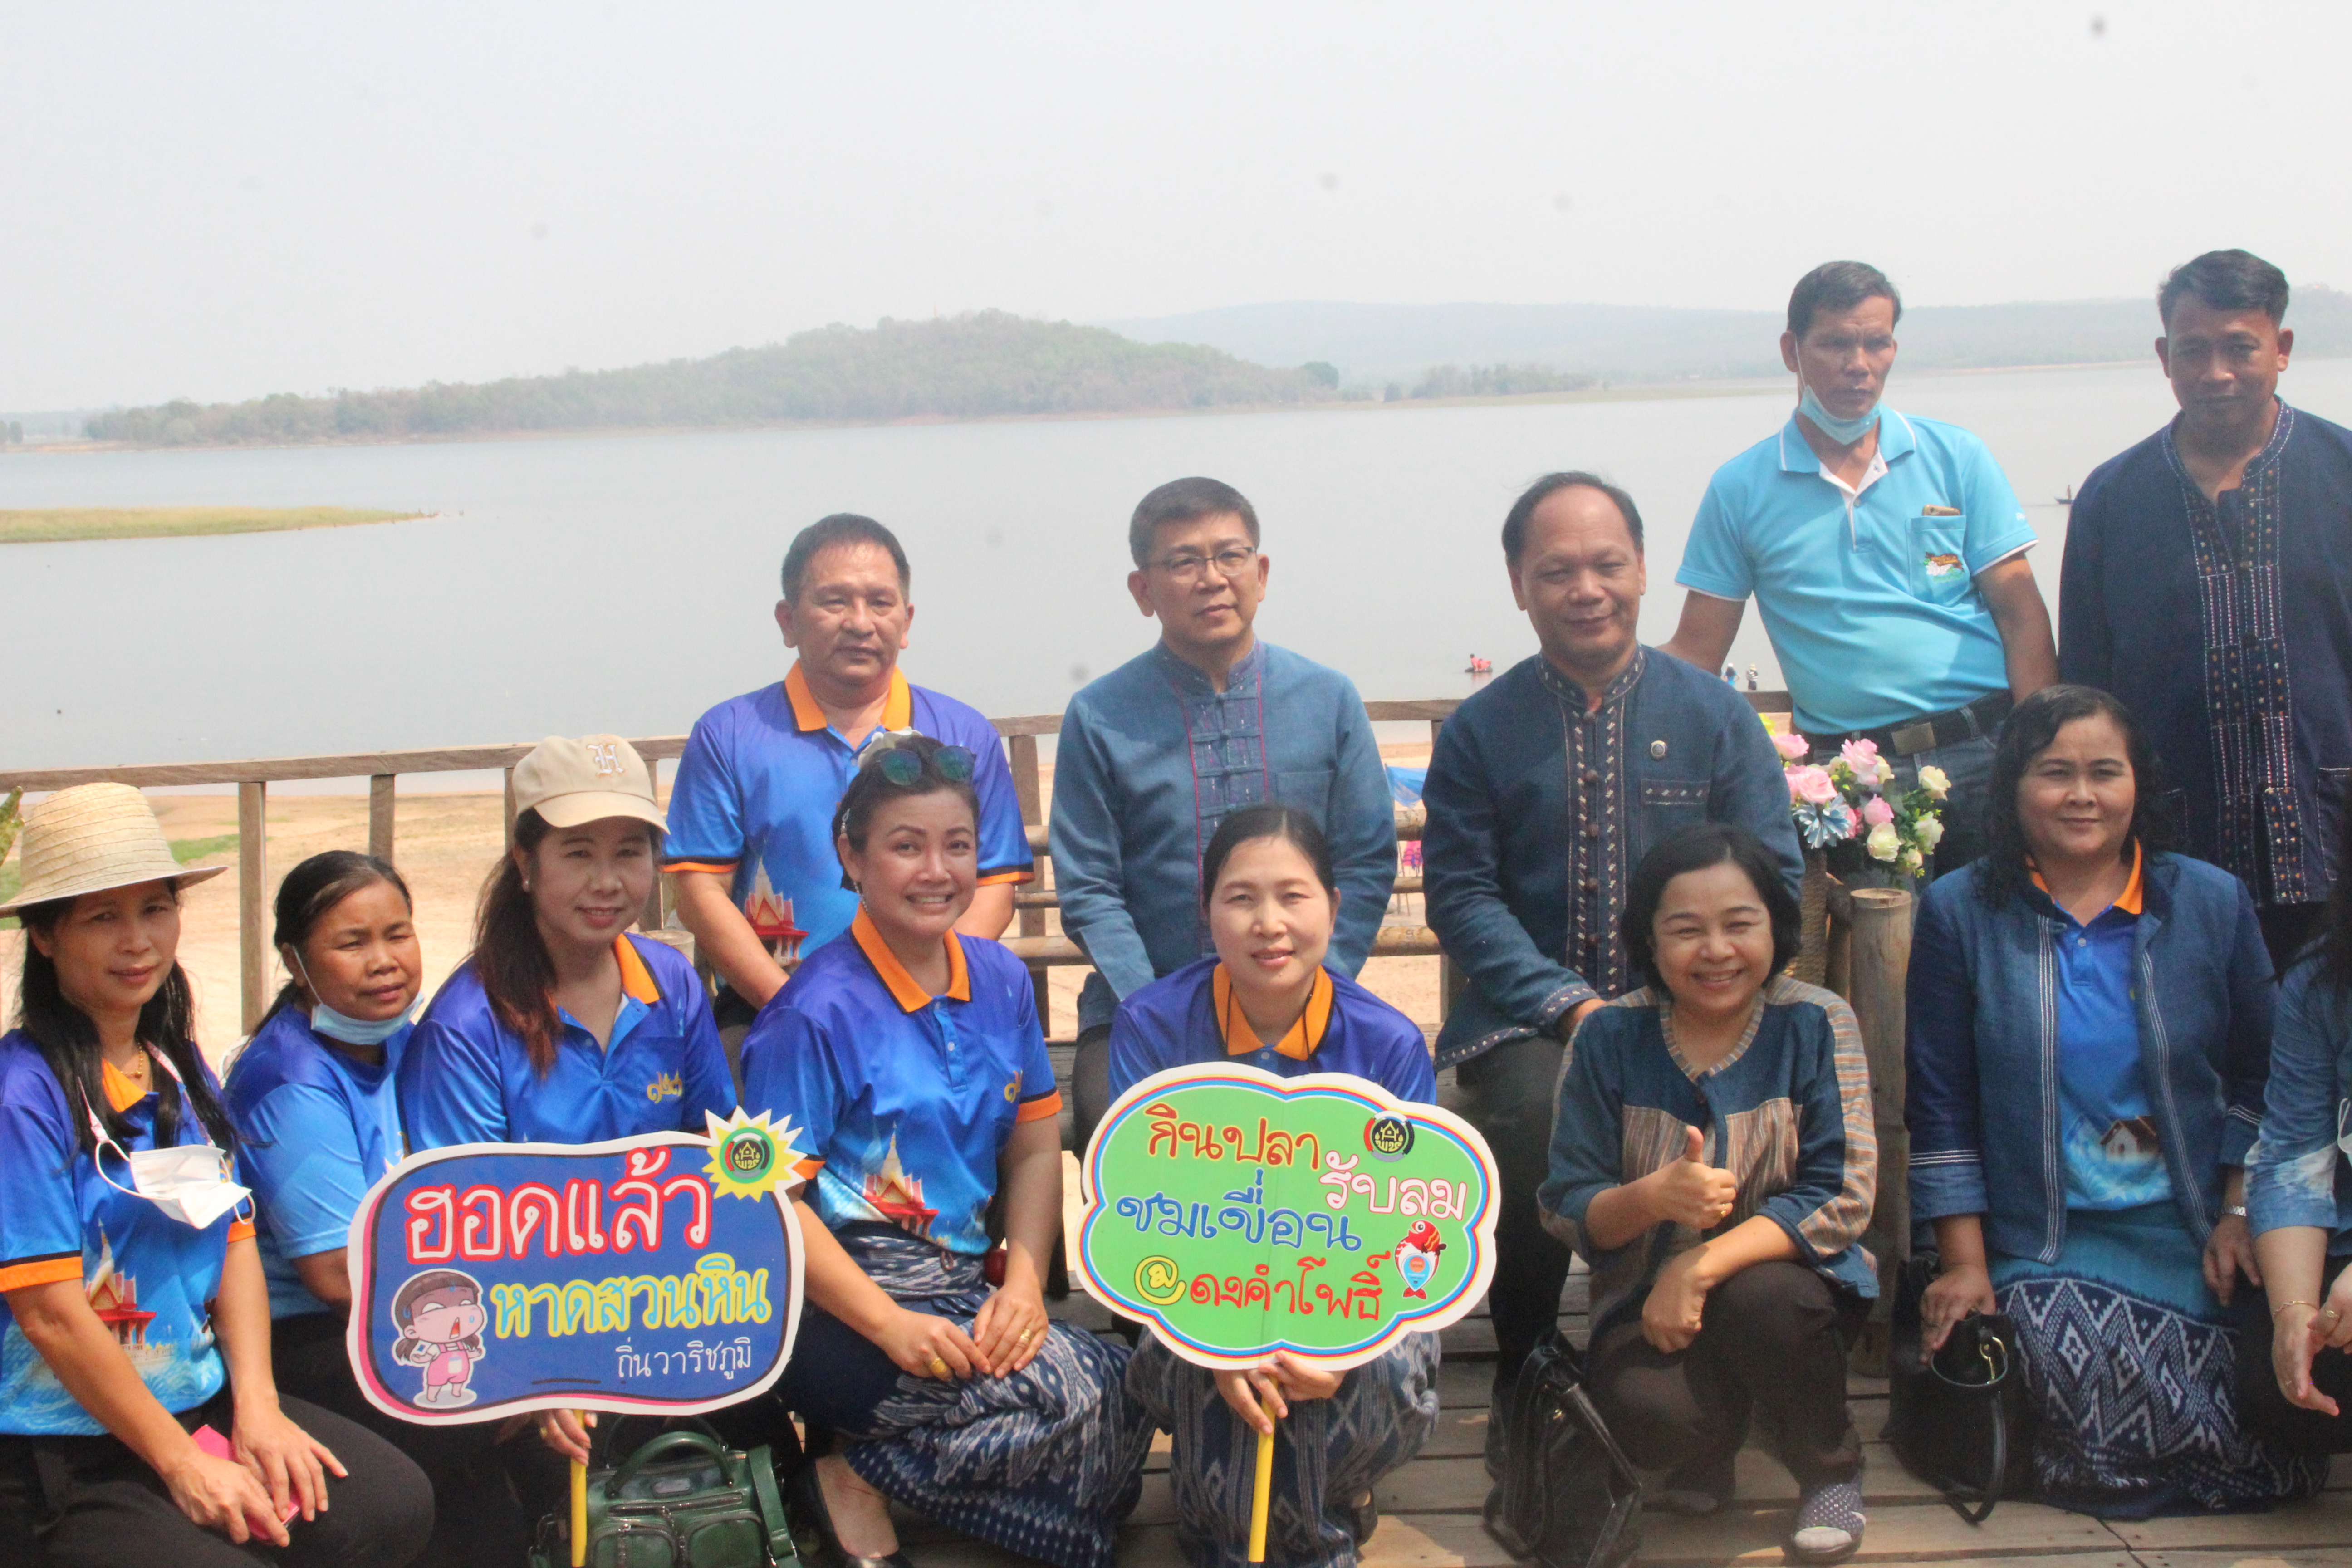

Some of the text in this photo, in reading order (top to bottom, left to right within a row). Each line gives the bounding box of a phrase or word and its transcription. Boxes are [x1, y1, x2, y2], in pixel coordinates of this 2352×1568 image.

[1145, 1102, 1319, 1171] กินปลา
[404, 1146, 712, 1264] ฮอดแล้ว
[1116, 1168, 1362, 1252] ชมเขื่อน
[1319, 1150, 1468, 1221] รับลม
[490, 1252, 771, 1339] หาดสวนหิน
